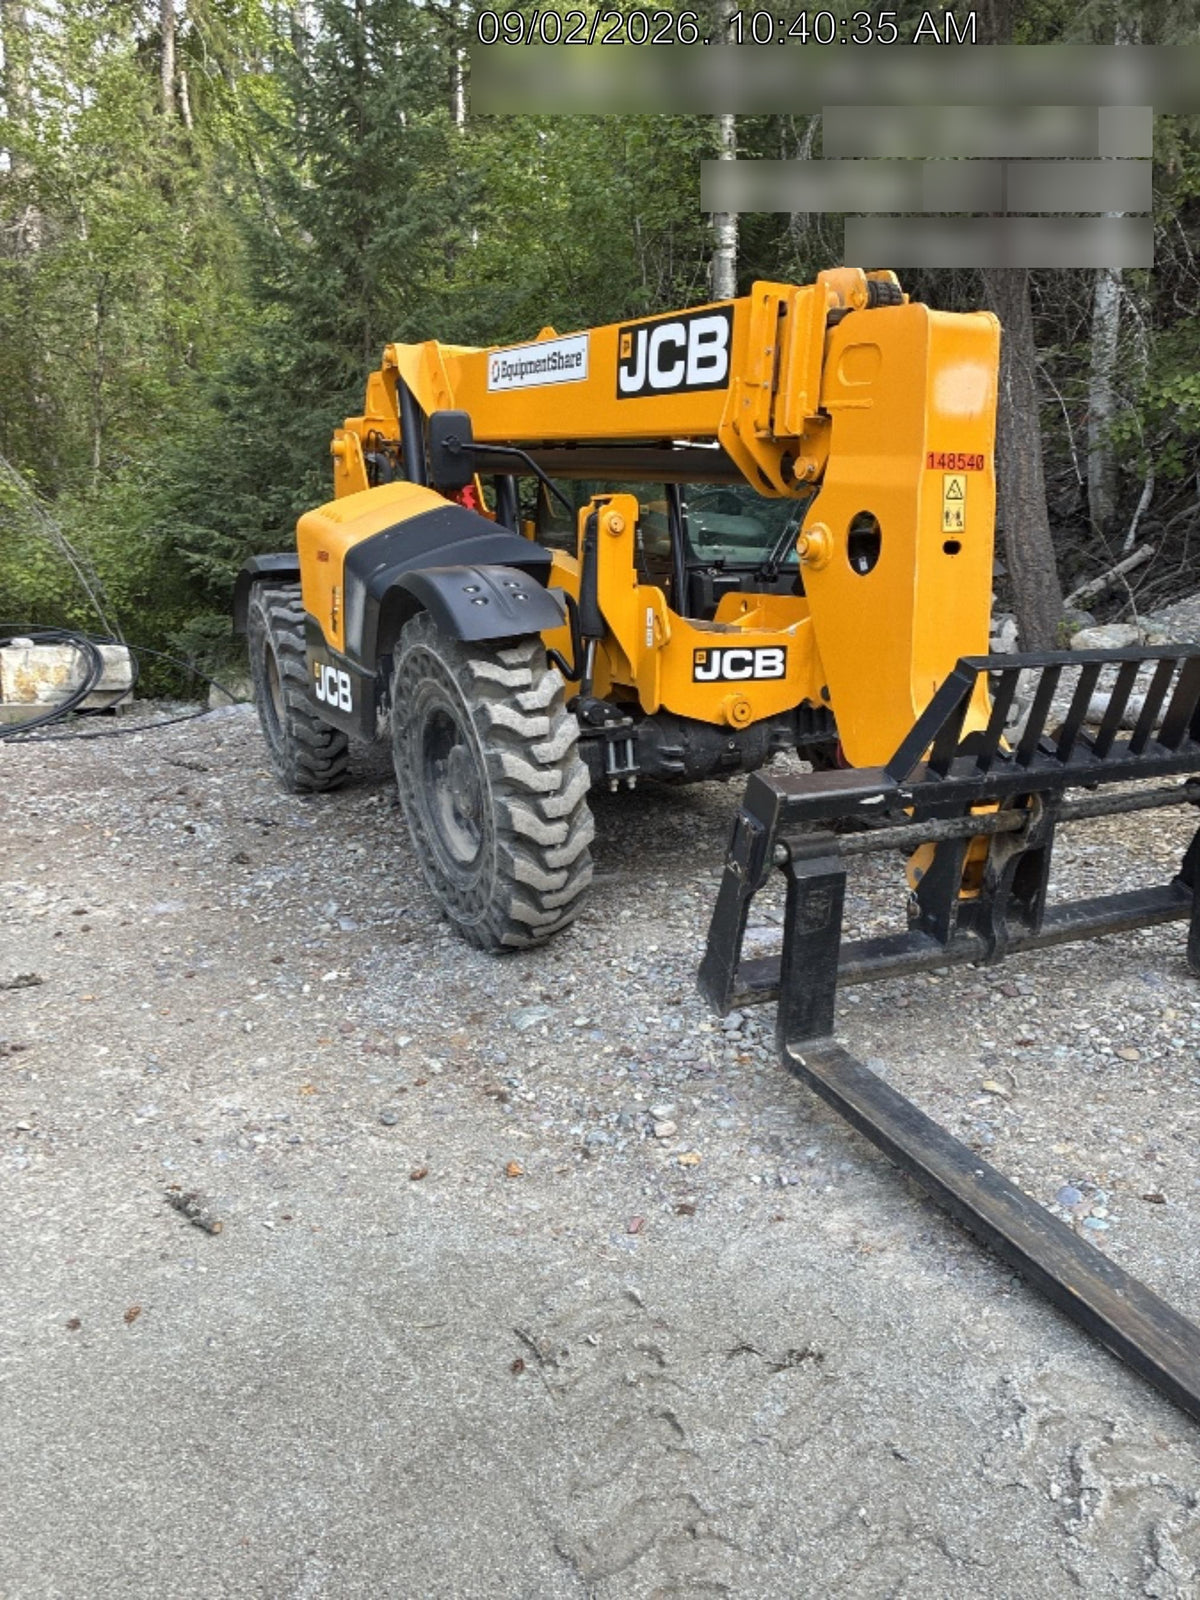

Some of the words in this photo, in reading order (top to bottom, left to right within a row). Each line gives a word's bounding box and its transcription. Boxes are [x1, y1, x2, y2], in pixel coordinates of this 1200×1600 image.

[501, 350, 582, 381] EquipmentShare
[619, 315, 730, 393] JCB
[694, 648, 785, 680] JCB
[315, 664, 353, 713] JCB
